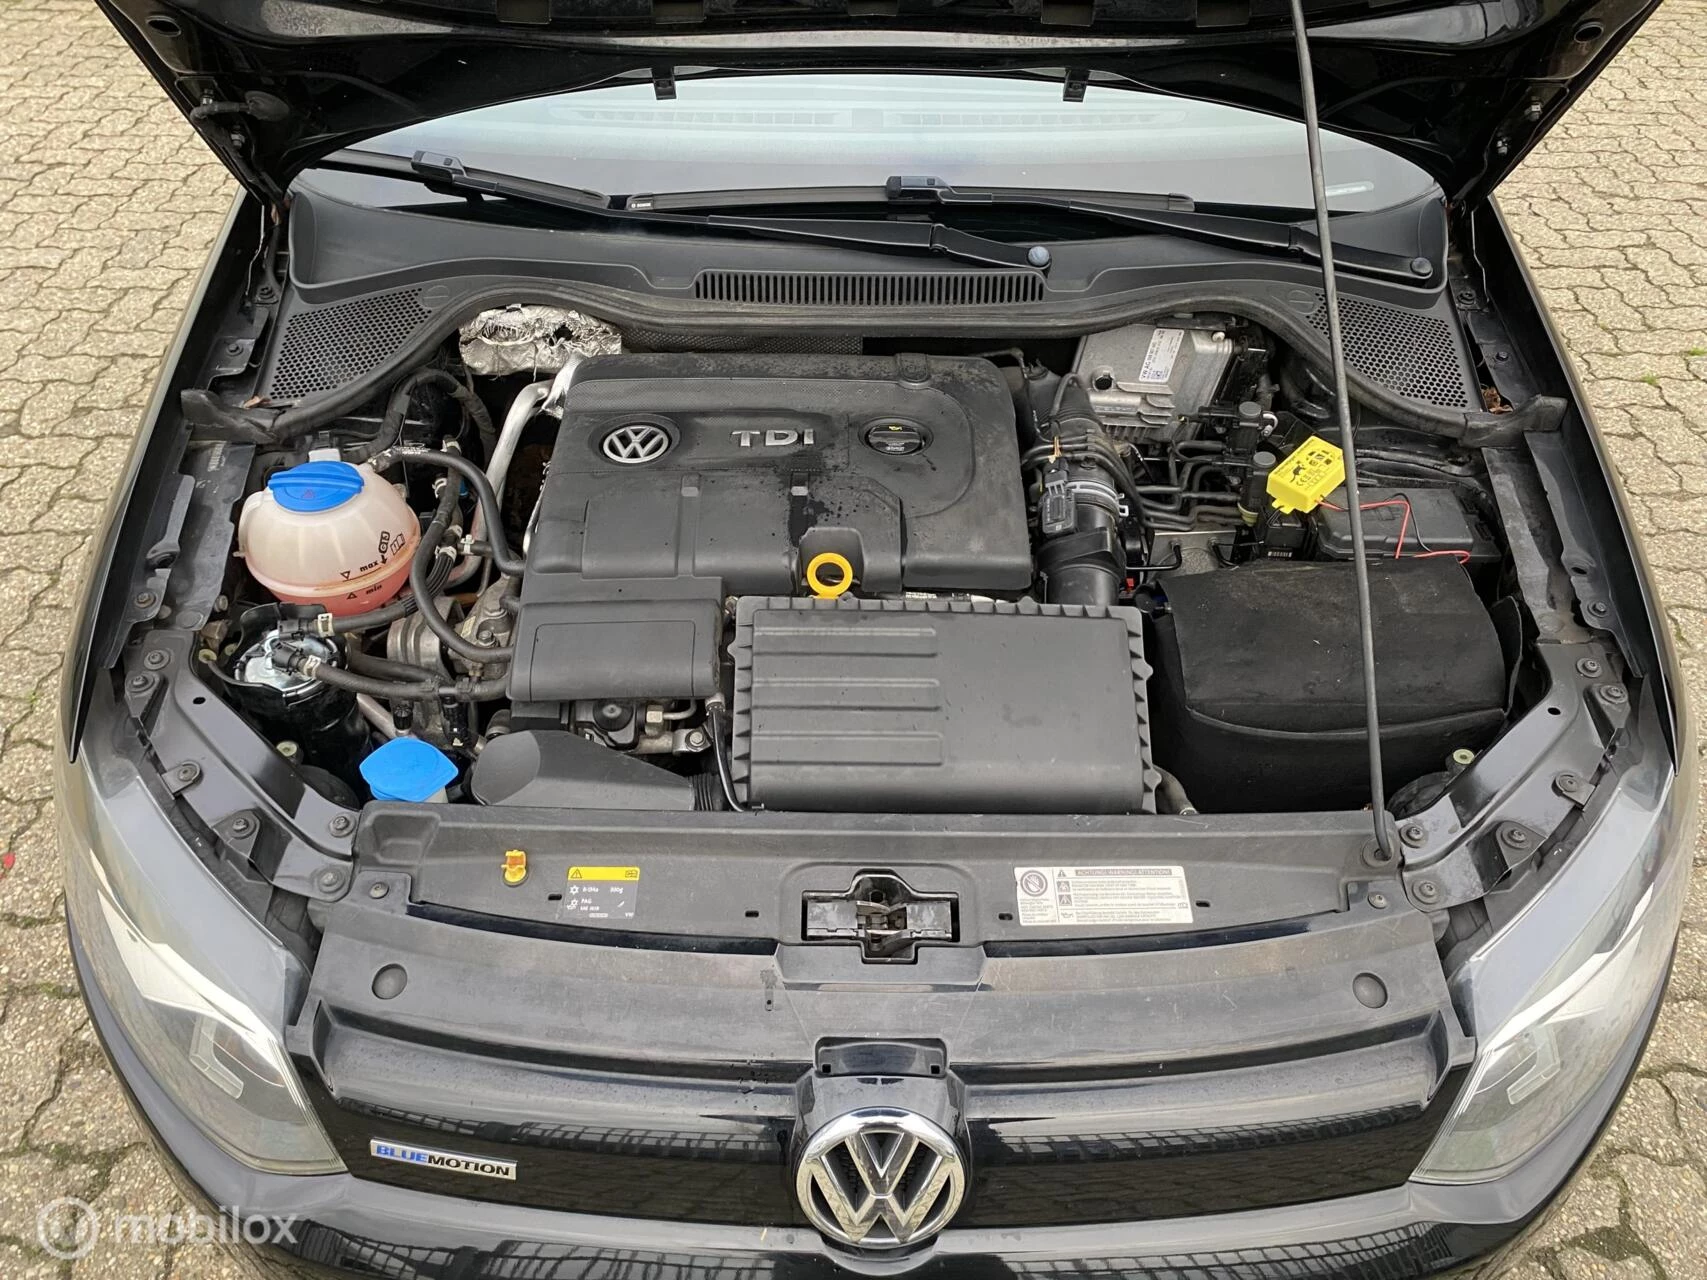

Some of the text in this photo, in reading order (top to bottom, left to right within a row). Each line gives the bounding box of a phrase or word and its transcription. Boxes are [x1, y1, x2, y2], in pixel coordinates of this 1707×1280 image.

[602, 425, 669, 464] VW
[731, 428, 814, 447] TDI
[360, 560, 379, 572] max
[366, 584, 382, 595] min
[376, 1145, 510, 1176] BLUEMOTION
[796, 1106, 965, 1250] VW
